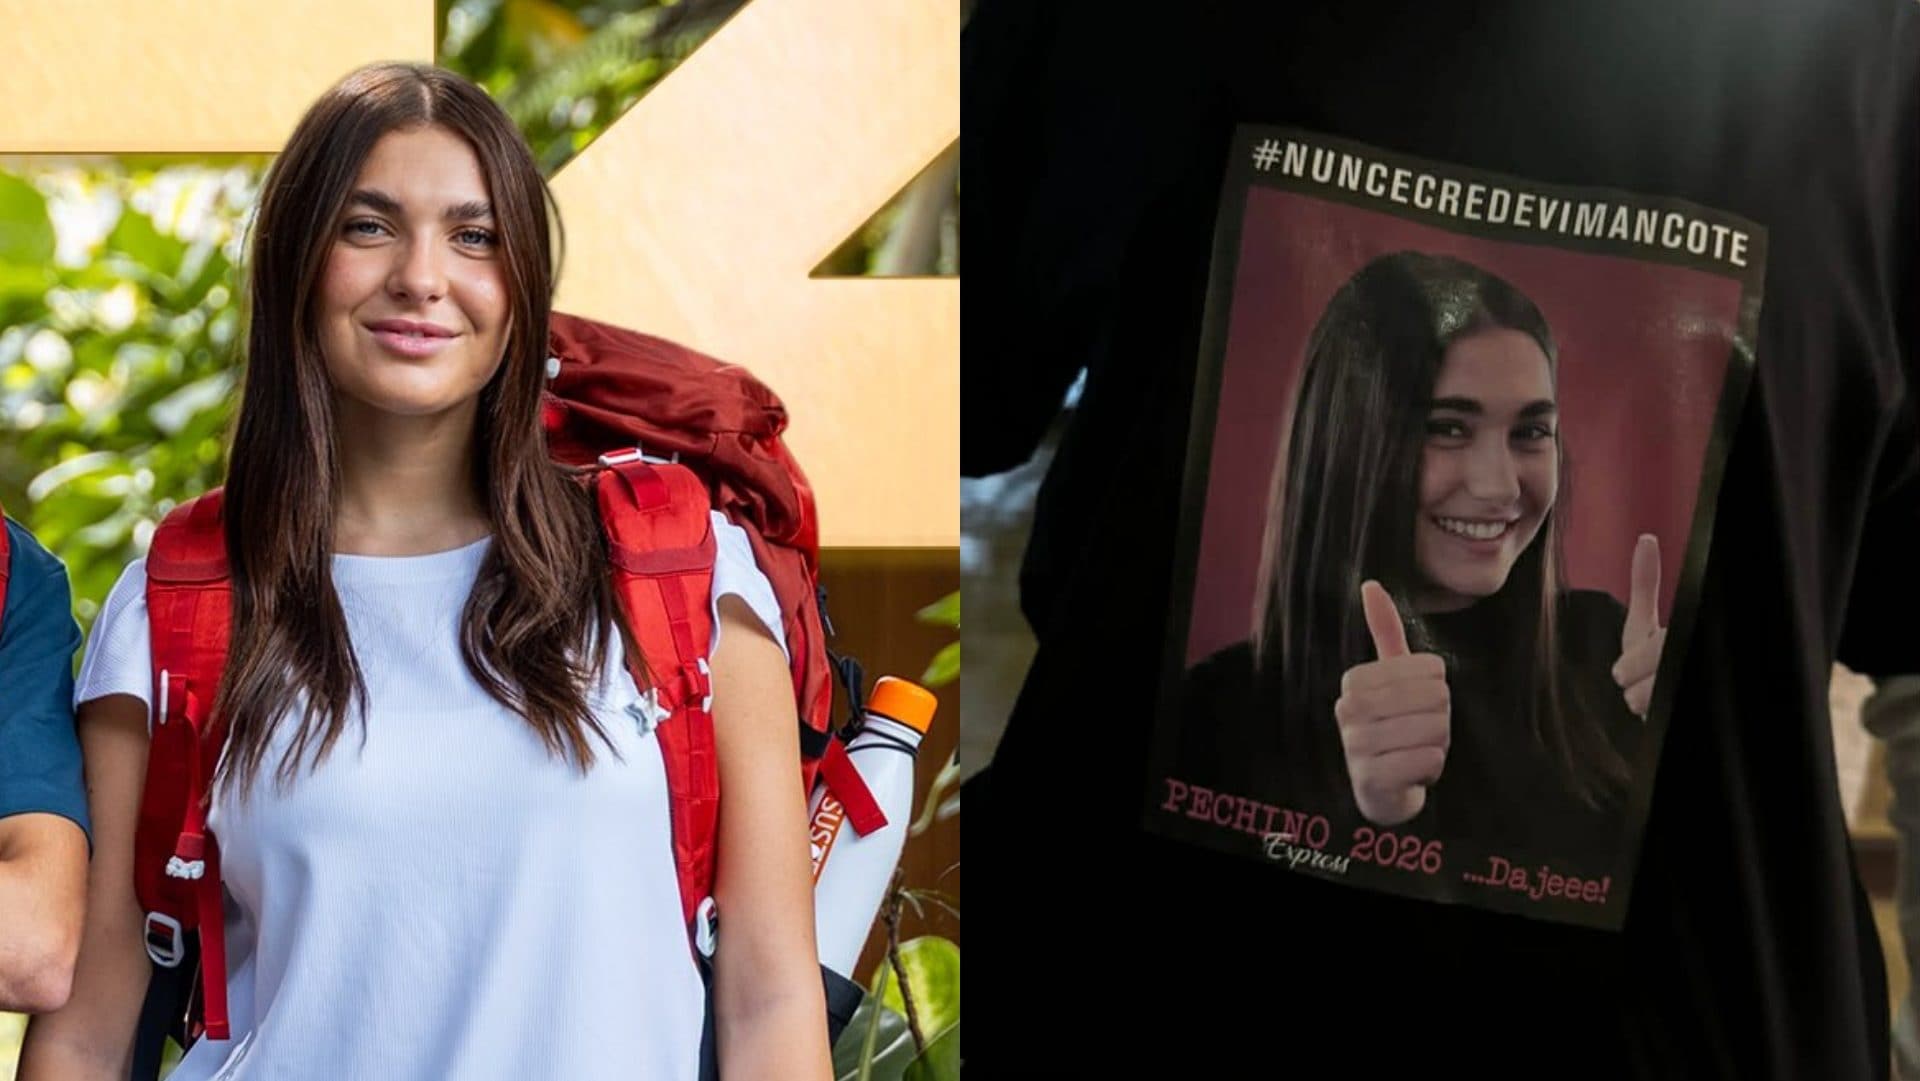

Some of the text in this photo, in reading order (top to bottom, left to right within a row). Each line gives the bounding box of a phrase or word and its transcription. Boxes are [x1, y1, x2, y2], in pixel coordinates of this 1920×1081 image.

[1253, 139, 1749, 267] #NUNCECREDEVIMANCOTE
[1162, 779, 1330, 849] PECHINO
[1352, 827, 1442, 873] 2026
[1264, 832, 1351, 874] Express
